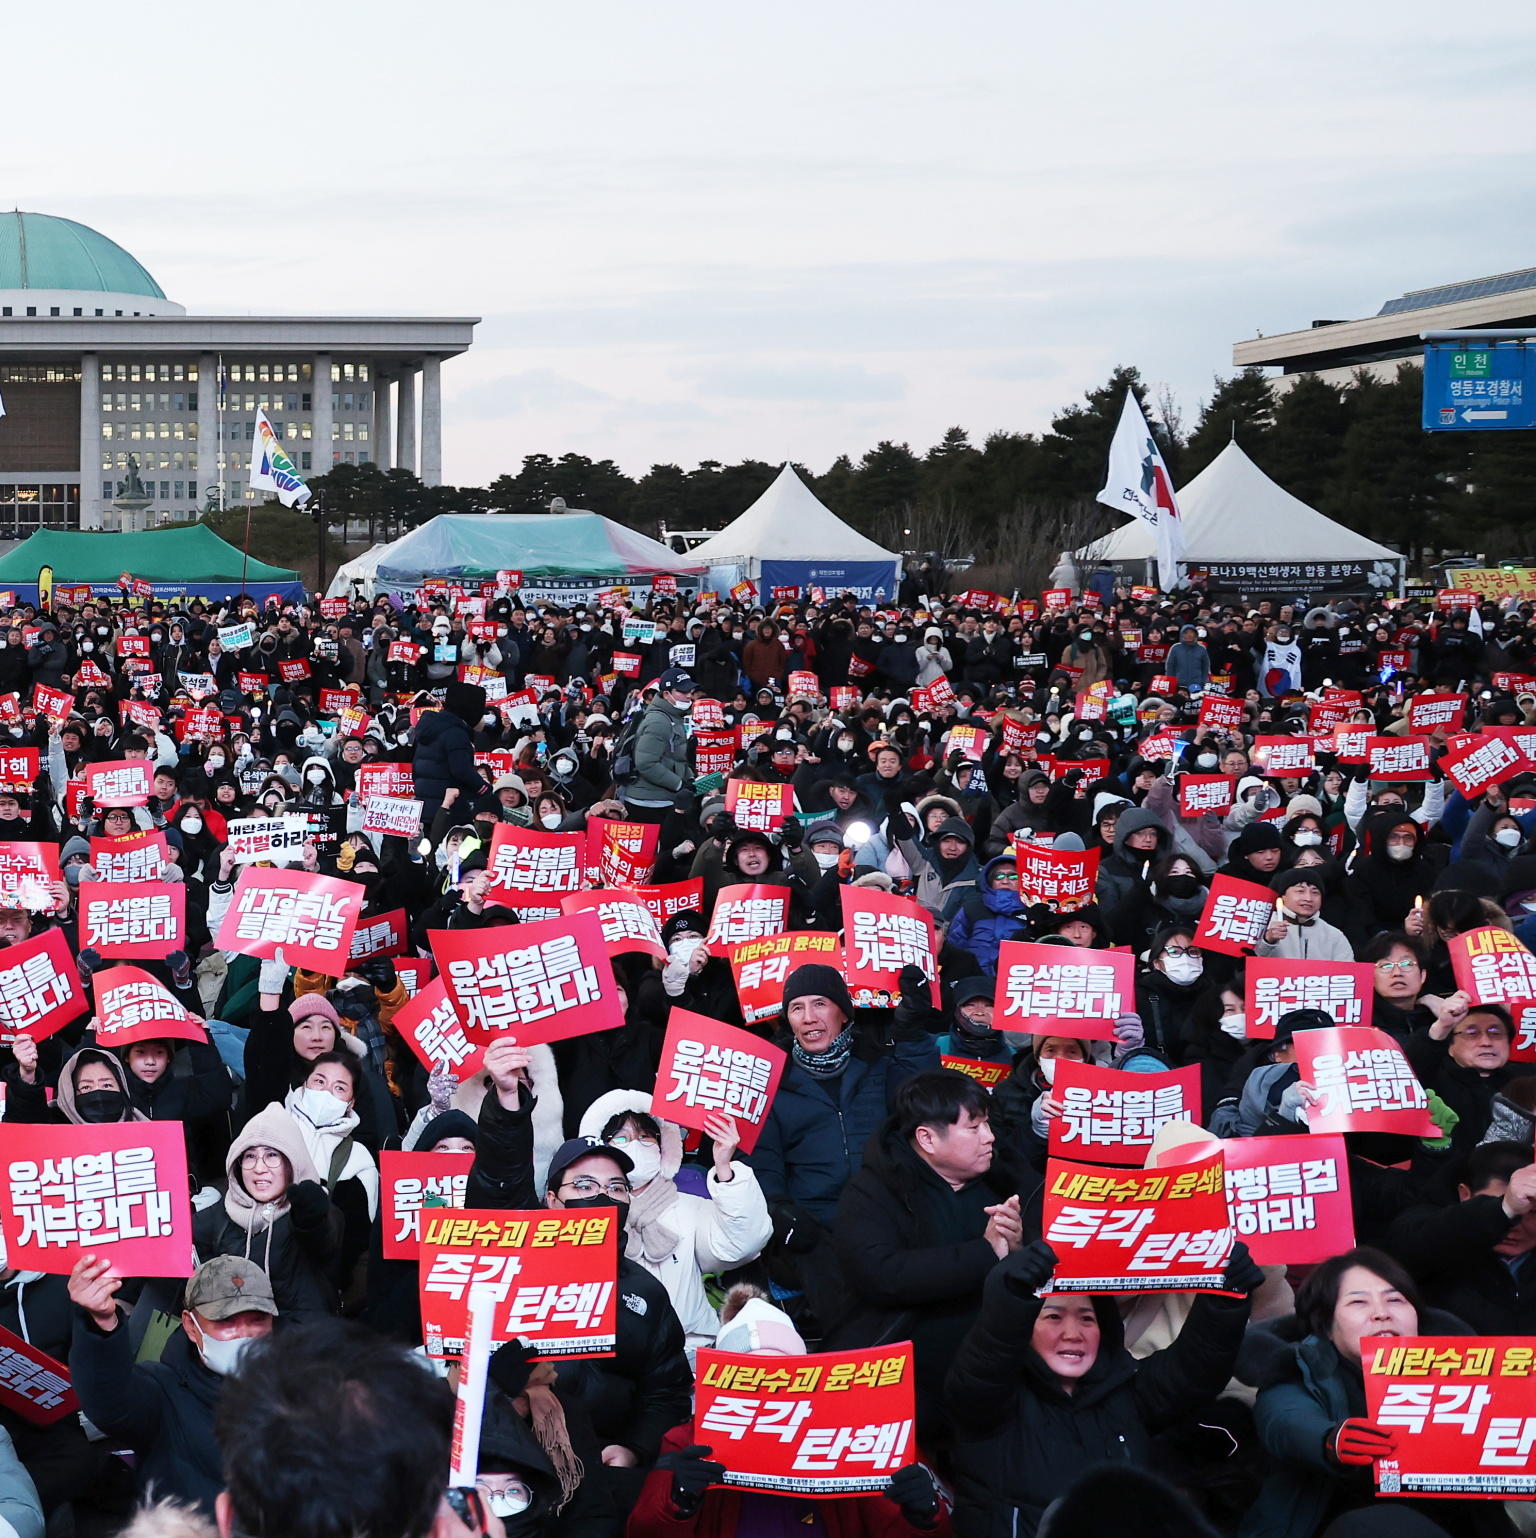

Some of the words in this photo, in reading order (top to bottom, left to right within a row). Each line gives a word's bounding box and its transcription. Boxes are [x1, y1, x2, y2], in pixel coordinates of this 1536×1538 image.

[1454, 354, 1487, 369] 인천
[1451, 380, 1522, 397] 영등포경찰서
[1305, 566, 1326, 577] 합동
[1330, 564, 1363, 577] 분향소
[1381, 653, 1405, 668] 탄핵
[1151, 679, 1170, 693] 탄핵
[37, 694, 66, 714] 탄핵
[192, 714, 220, 725] 내란수괴
[1369, 743, 1426, 763] 윤석열을
[1369, 755, 1429, 774] 거부한다!
[93, 767, 146, 786] 윤석열을
[93, 779, 150, 800] 거부한다!
[1184, 780, 1231, 798] 윤석열을
[737, 783, 782, 800] 내란죄
[1185, 792, 1232, 812] 거부한다!
[735, 798, 782, 817] 윤석열
[227, 820, 286, 836] 내란죄로
[734, 814, 771, 831] 탄핵!
[95, 843, 162, 869] 윤석열을
[233, 829, 306, 855] 처벌하라
[495, 844, 577, 871] 윤석열을
[1025, 857, 1085, 879] 내란수괴
[489, 867, 581, 893] 거부한다!
[1020, 872, 1059, 897] 윤석열
[1059, 877, 1090, 898] 체포
[86, 893, 172, 925] 윤석열을
[664, 893, 701, 916] 힘으로
[86, 917, 178, 947] 거부한다!
[733, 938, 792, 964] 내란수괴
[792, 935, 841, 953] 윤석열
[448, 933, 580, 999] 윤석열을
[739, 956, 791, 990] 즉각
[1006, 964, 1116, 993] 윤석열을
[458, 965, 603, 1032] 거부한다!
[1253, 973, 1356, 1002] 윤석열을
[103, 1003, 186, 1035] 수용하라!
[1002, 991, 1123, 1020] 거부한다!
[671, 1038, 773, 1097] 윤석열을
[1311, 1048, 1417, 1085] 윤석열을
[664, 1071, 770, 1126] 거부한다!
[1061, 1084, 1185, 1119] 윤석열을
[1313, 1079, 1429, 1117] 거부한다!
[1060, 1110, 1193, 1146] 거부한
[7, 1146, 157, 1206] 윤석열을
[1049, 1171, 1168, 1204] 내란수괴
[1167, 1160, 1225, 1201] 윤석열
[12, 1192, 173, 1250] 거부한다!
[424, 1218, 532, 1248] 내란수괴
[531, 1217, 611, 1249] 윤석열
[1045, 1205, 1157, 1250] 즉각
[1125, 1226, 1236, 1272] 탄핵!
[424, 1253, 523, 1303] 즉각
[505, 1281, 615, 1334] 탄핵!
[701, 1363, 824, 1394] 내란수괴
[823, 1355, 907, 1393] 윤석열
[1370, 1346, 1496, 1377] 내란수괴
[700, 1395, 813, 1444] 즉각
[1375, 1383, 1493, 1435] 즉각
[790, 1418, 913, 1471] 탄핵!
